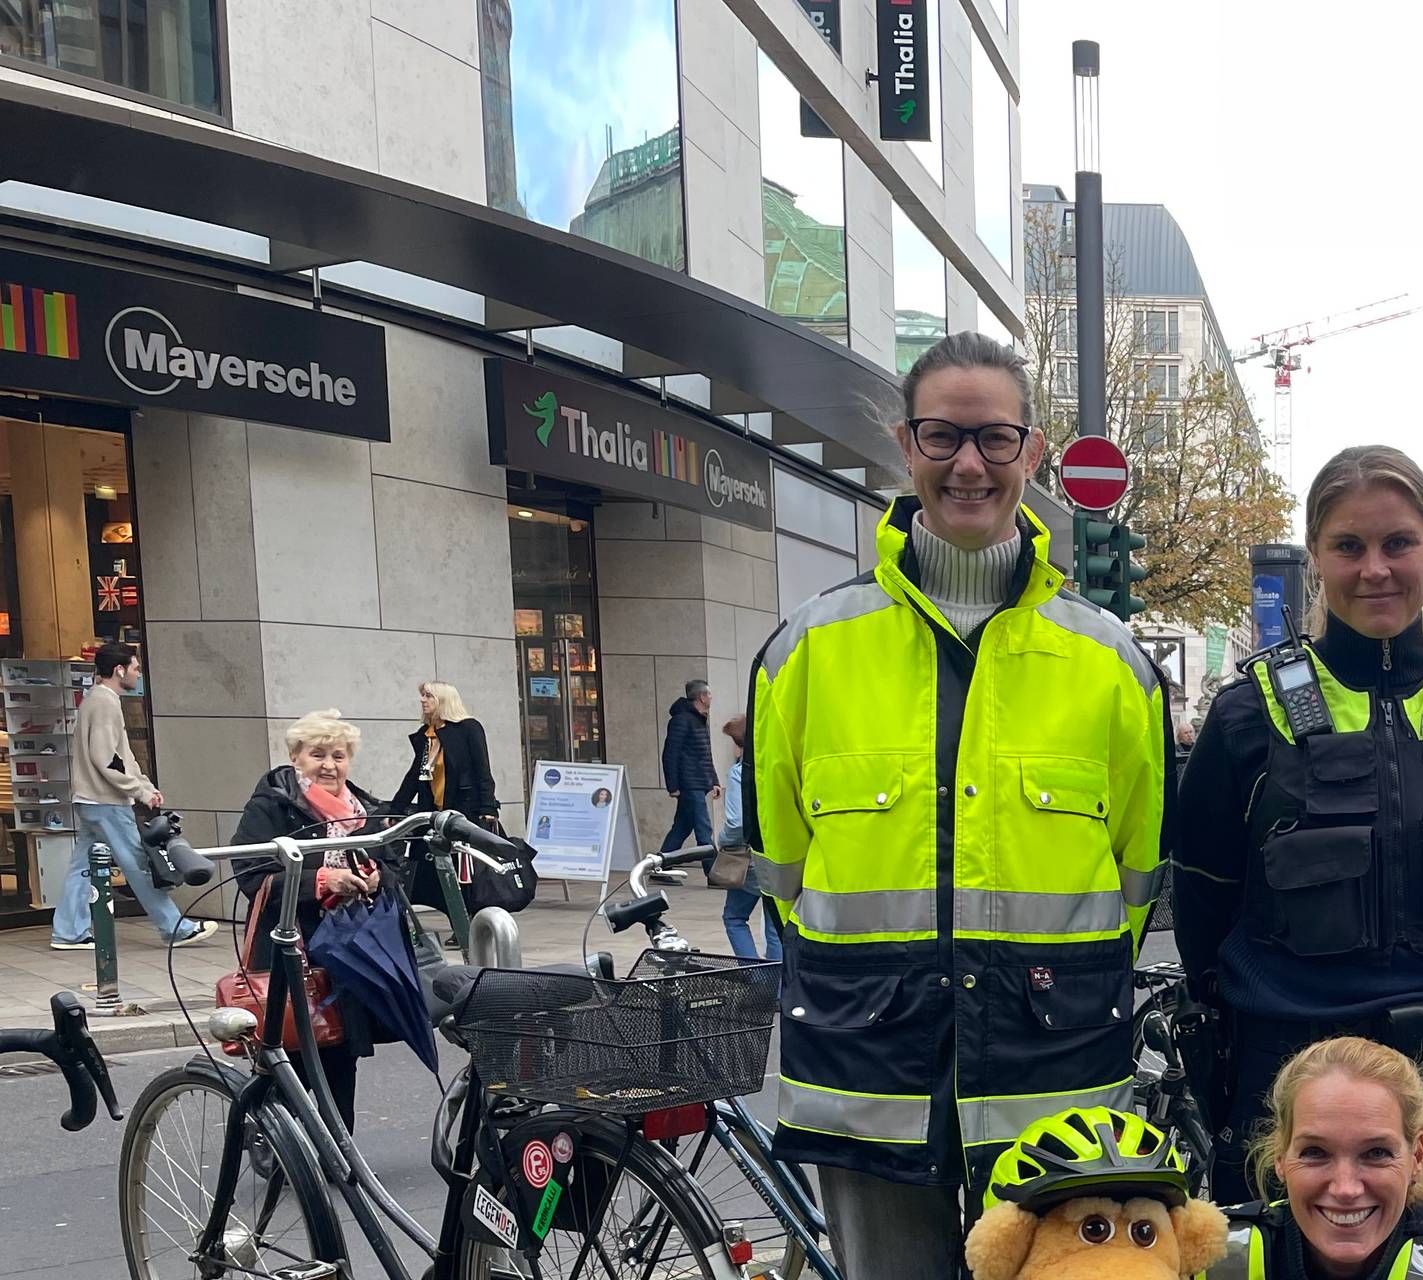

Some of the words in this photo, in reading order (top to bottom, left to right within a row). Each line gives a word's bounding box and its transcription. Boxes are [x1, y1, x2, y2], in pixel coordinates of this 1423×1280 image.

[893, 13, 915, 95] Thalia
[123, 327, 357, 406] Mayersche
[560, 405, 648, 473] Thalia
[708, 463, 767, 509] Mayersche
[476, 1193, 518, 1241] LEGENDEN
